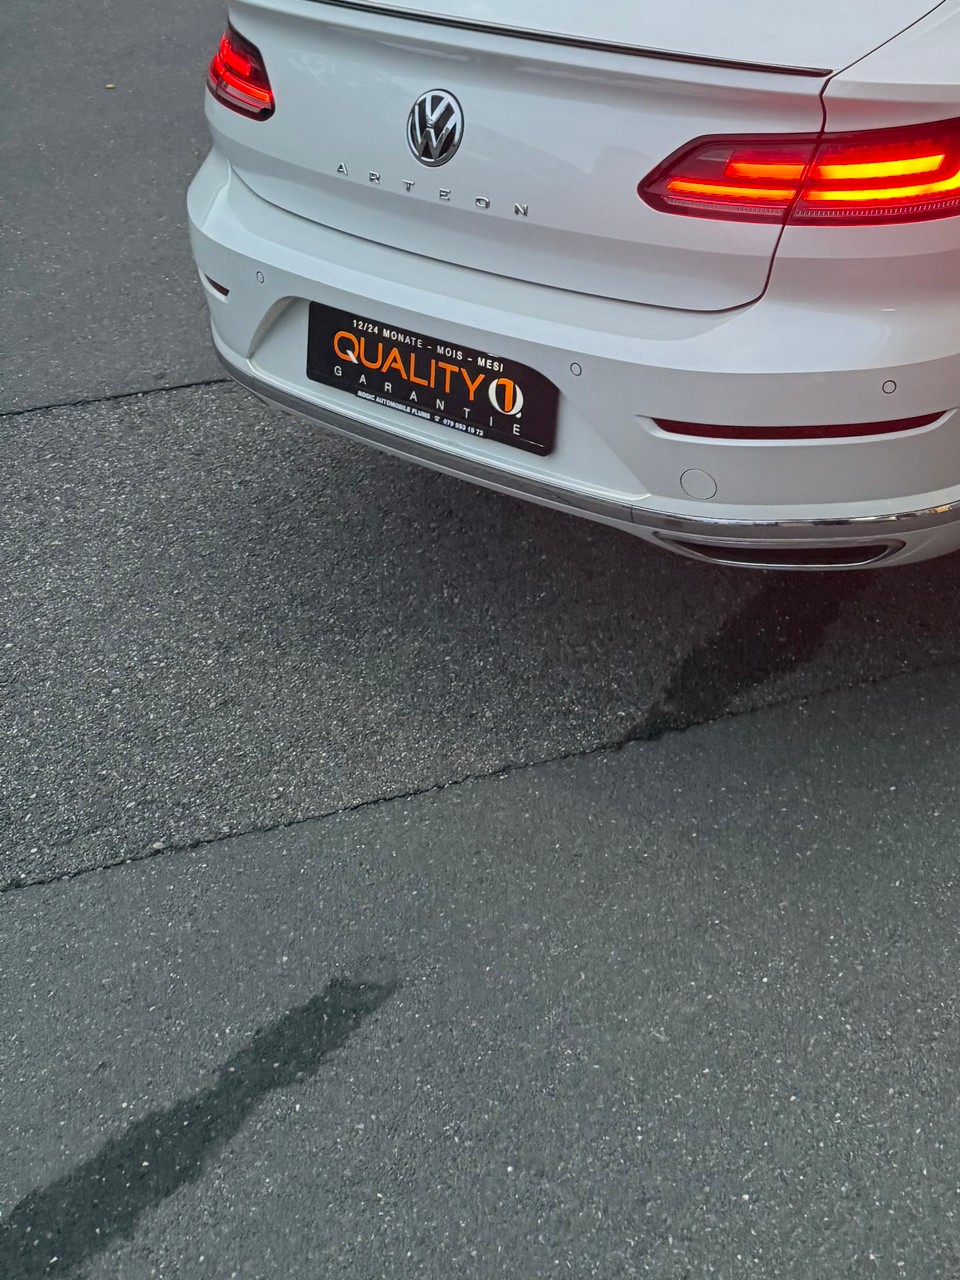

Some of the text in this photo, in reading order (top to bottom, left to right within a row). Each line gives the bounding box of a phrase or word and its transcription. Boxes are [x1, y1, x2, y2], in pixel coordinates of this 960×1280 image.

[337, 162, 529, 217] ARTEON
[333, 331, 485, 401] QUALITY
[352, 319, 379, 334] 12/24
[382, 329, 423, 348] MONATE
[437, 345, 463, 360] MOIS
[477, 356, 504, 372] MESI
[334, 366, 520, 436] GARANTIE
[375, 396, 411, 414] AUTOMOBILE
